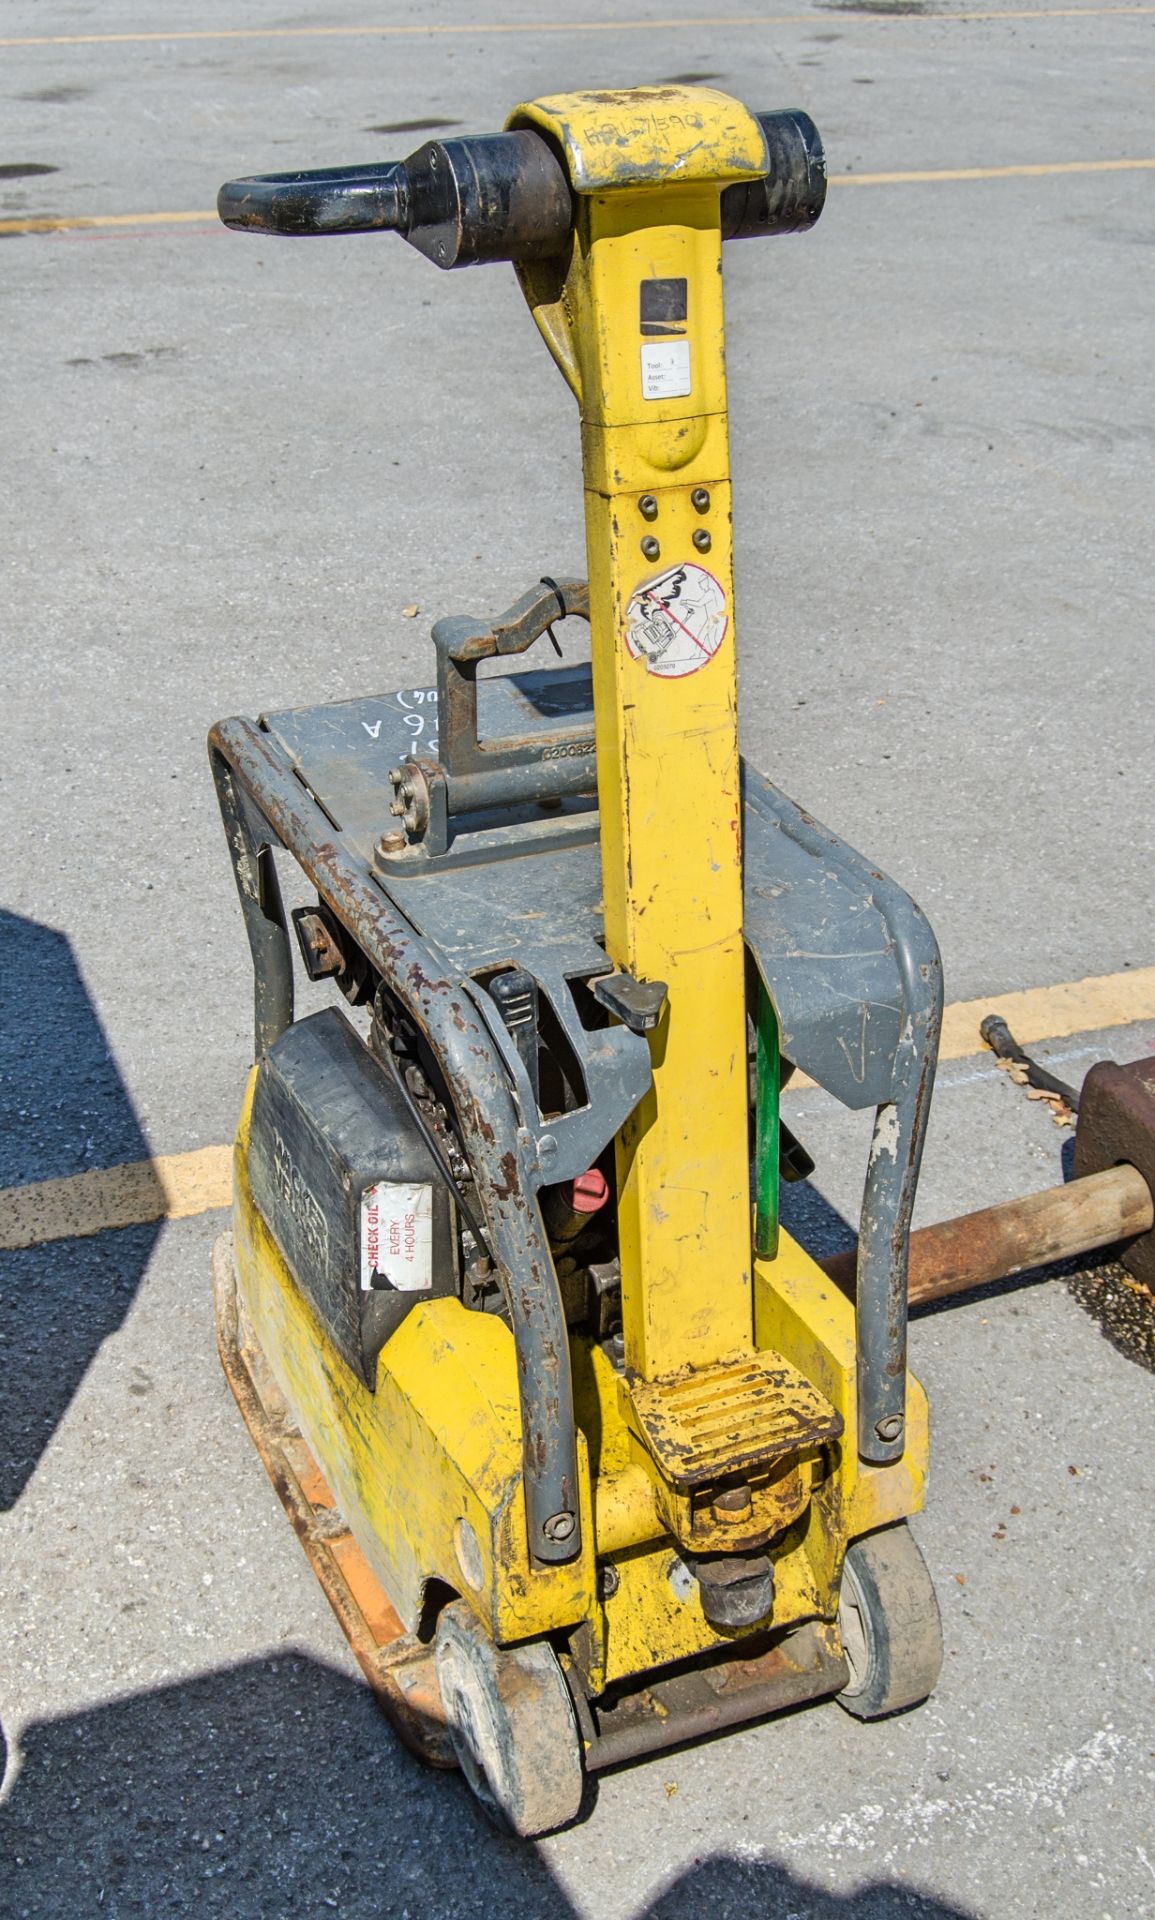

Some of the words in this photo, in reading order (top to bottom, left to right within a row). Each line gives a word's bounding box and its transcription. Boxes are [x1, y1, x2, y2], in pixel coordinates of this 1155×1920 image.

[361, 720, 383, 738] A
[367, 1204, 379, 1225] OIL
[367, 1227, 379, 1268] CHECK
[390, 1219, 400, 1255] EVERY
[404, 1213, 416, 1253] HOURS
